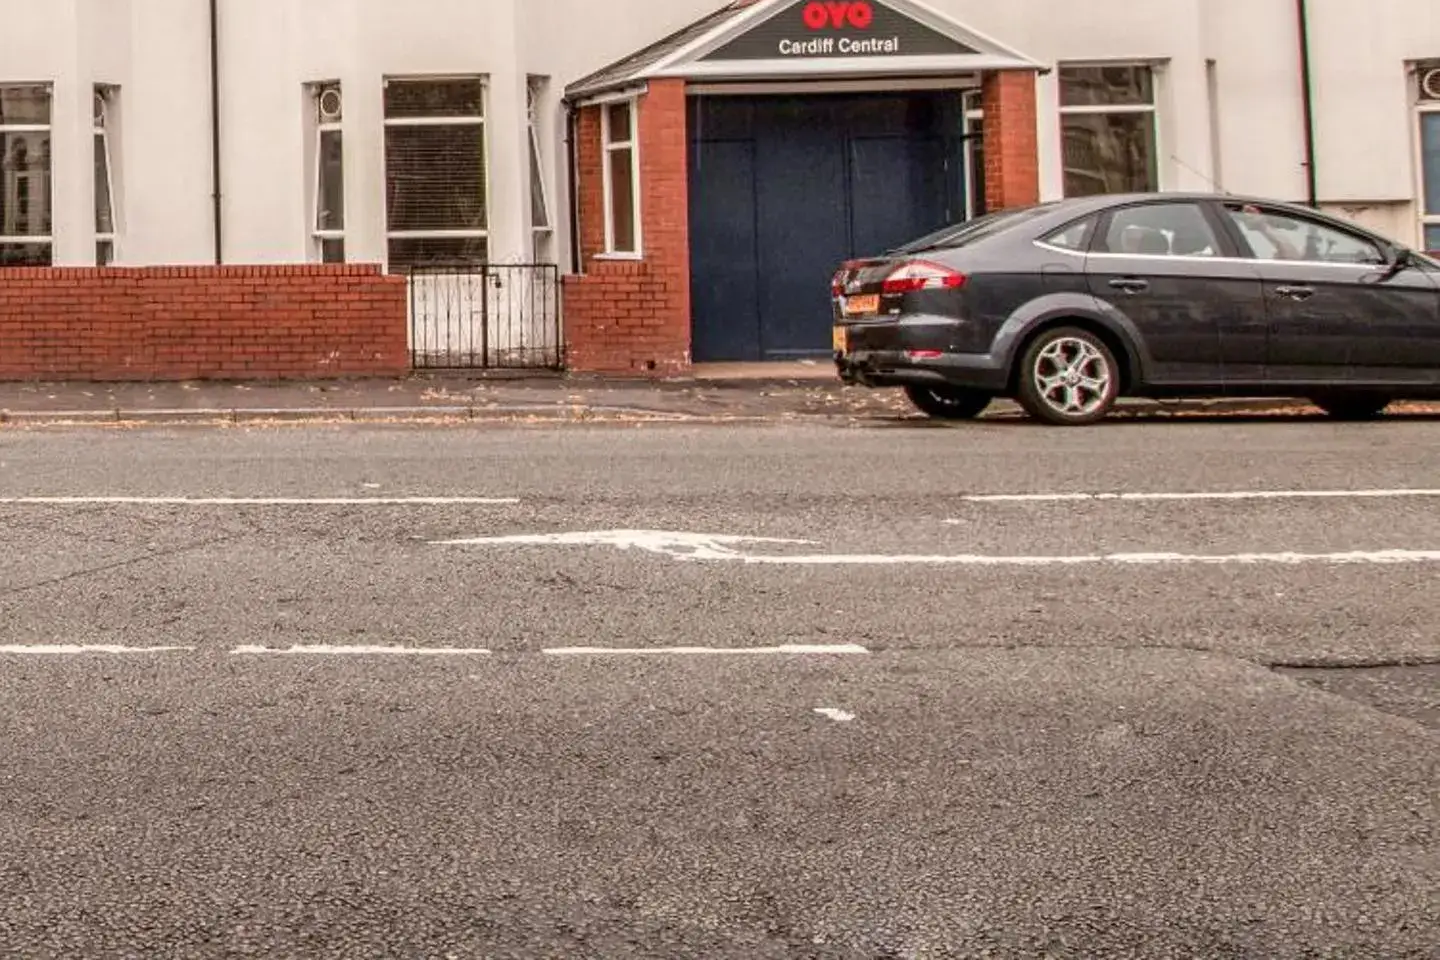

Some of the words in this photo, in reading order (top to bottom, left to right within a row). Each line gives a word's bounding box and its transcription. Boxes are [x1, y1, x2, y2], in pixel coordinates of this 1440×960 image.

[803, 0, 873, 29] OYO
[779, 38, 833, 54] Cardiff
[839, 37, 898, 53] Central
